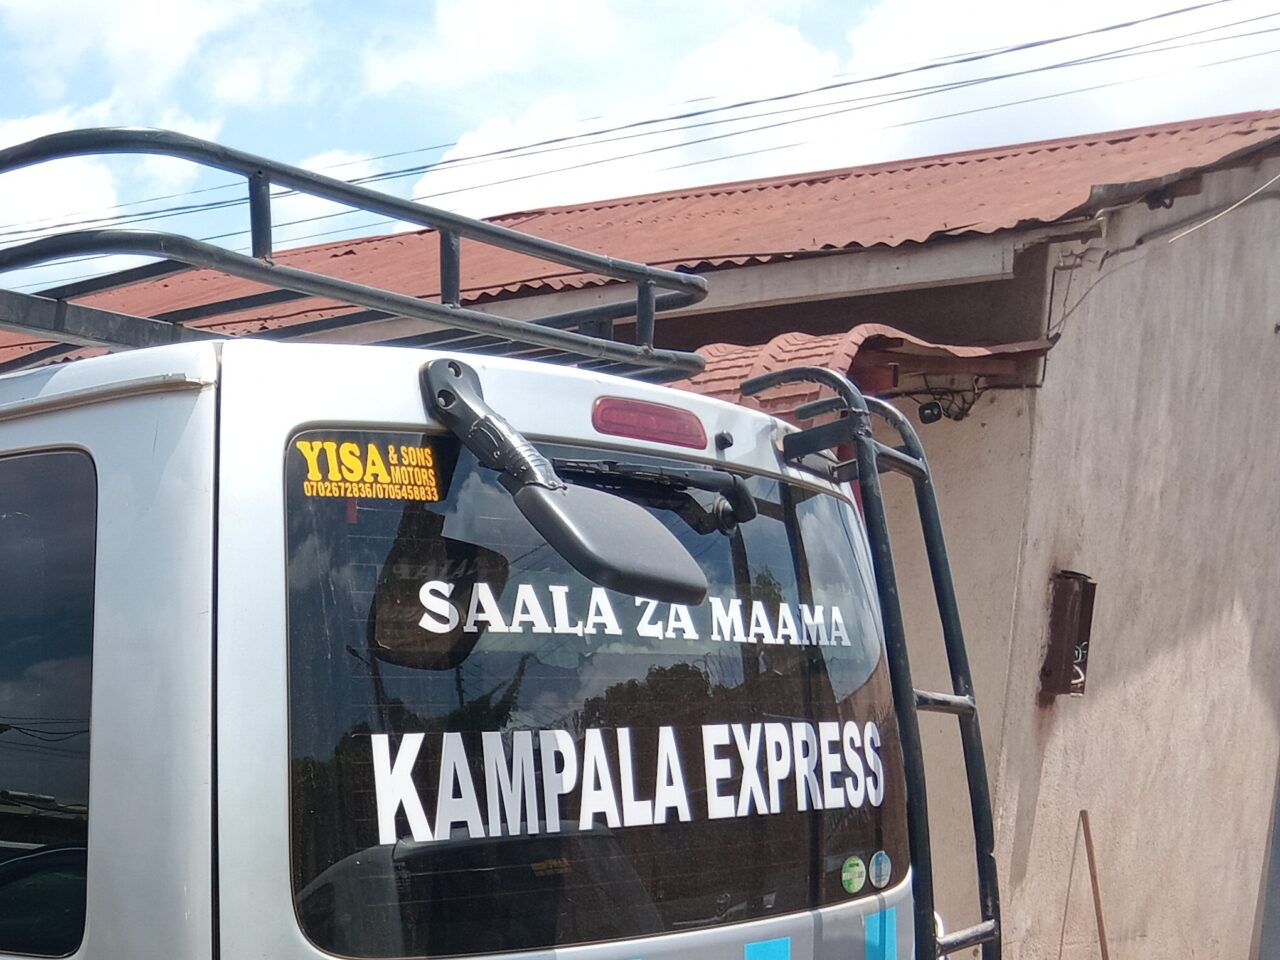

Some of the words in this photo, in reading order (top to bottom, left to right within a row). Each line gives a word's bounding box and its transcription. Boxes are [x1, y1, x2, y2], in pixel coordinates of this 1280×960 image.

[296, 441, 391, 484] YISA
[388, 444, 398, 464] &
[401, 445, 433, 467] SONS
[390, 466, 436, 487] MOTORS
[303, 481, 439, 502] 0702672836/0705458833
[418, 580, 623, 635] SAALA
[634, 597, 699, 640] ZA
[709, 597, 852, 646] MAAMA
[371, 726, 692, 845] KAMPALA
[702, 721, 885, 820] EXPRESS
